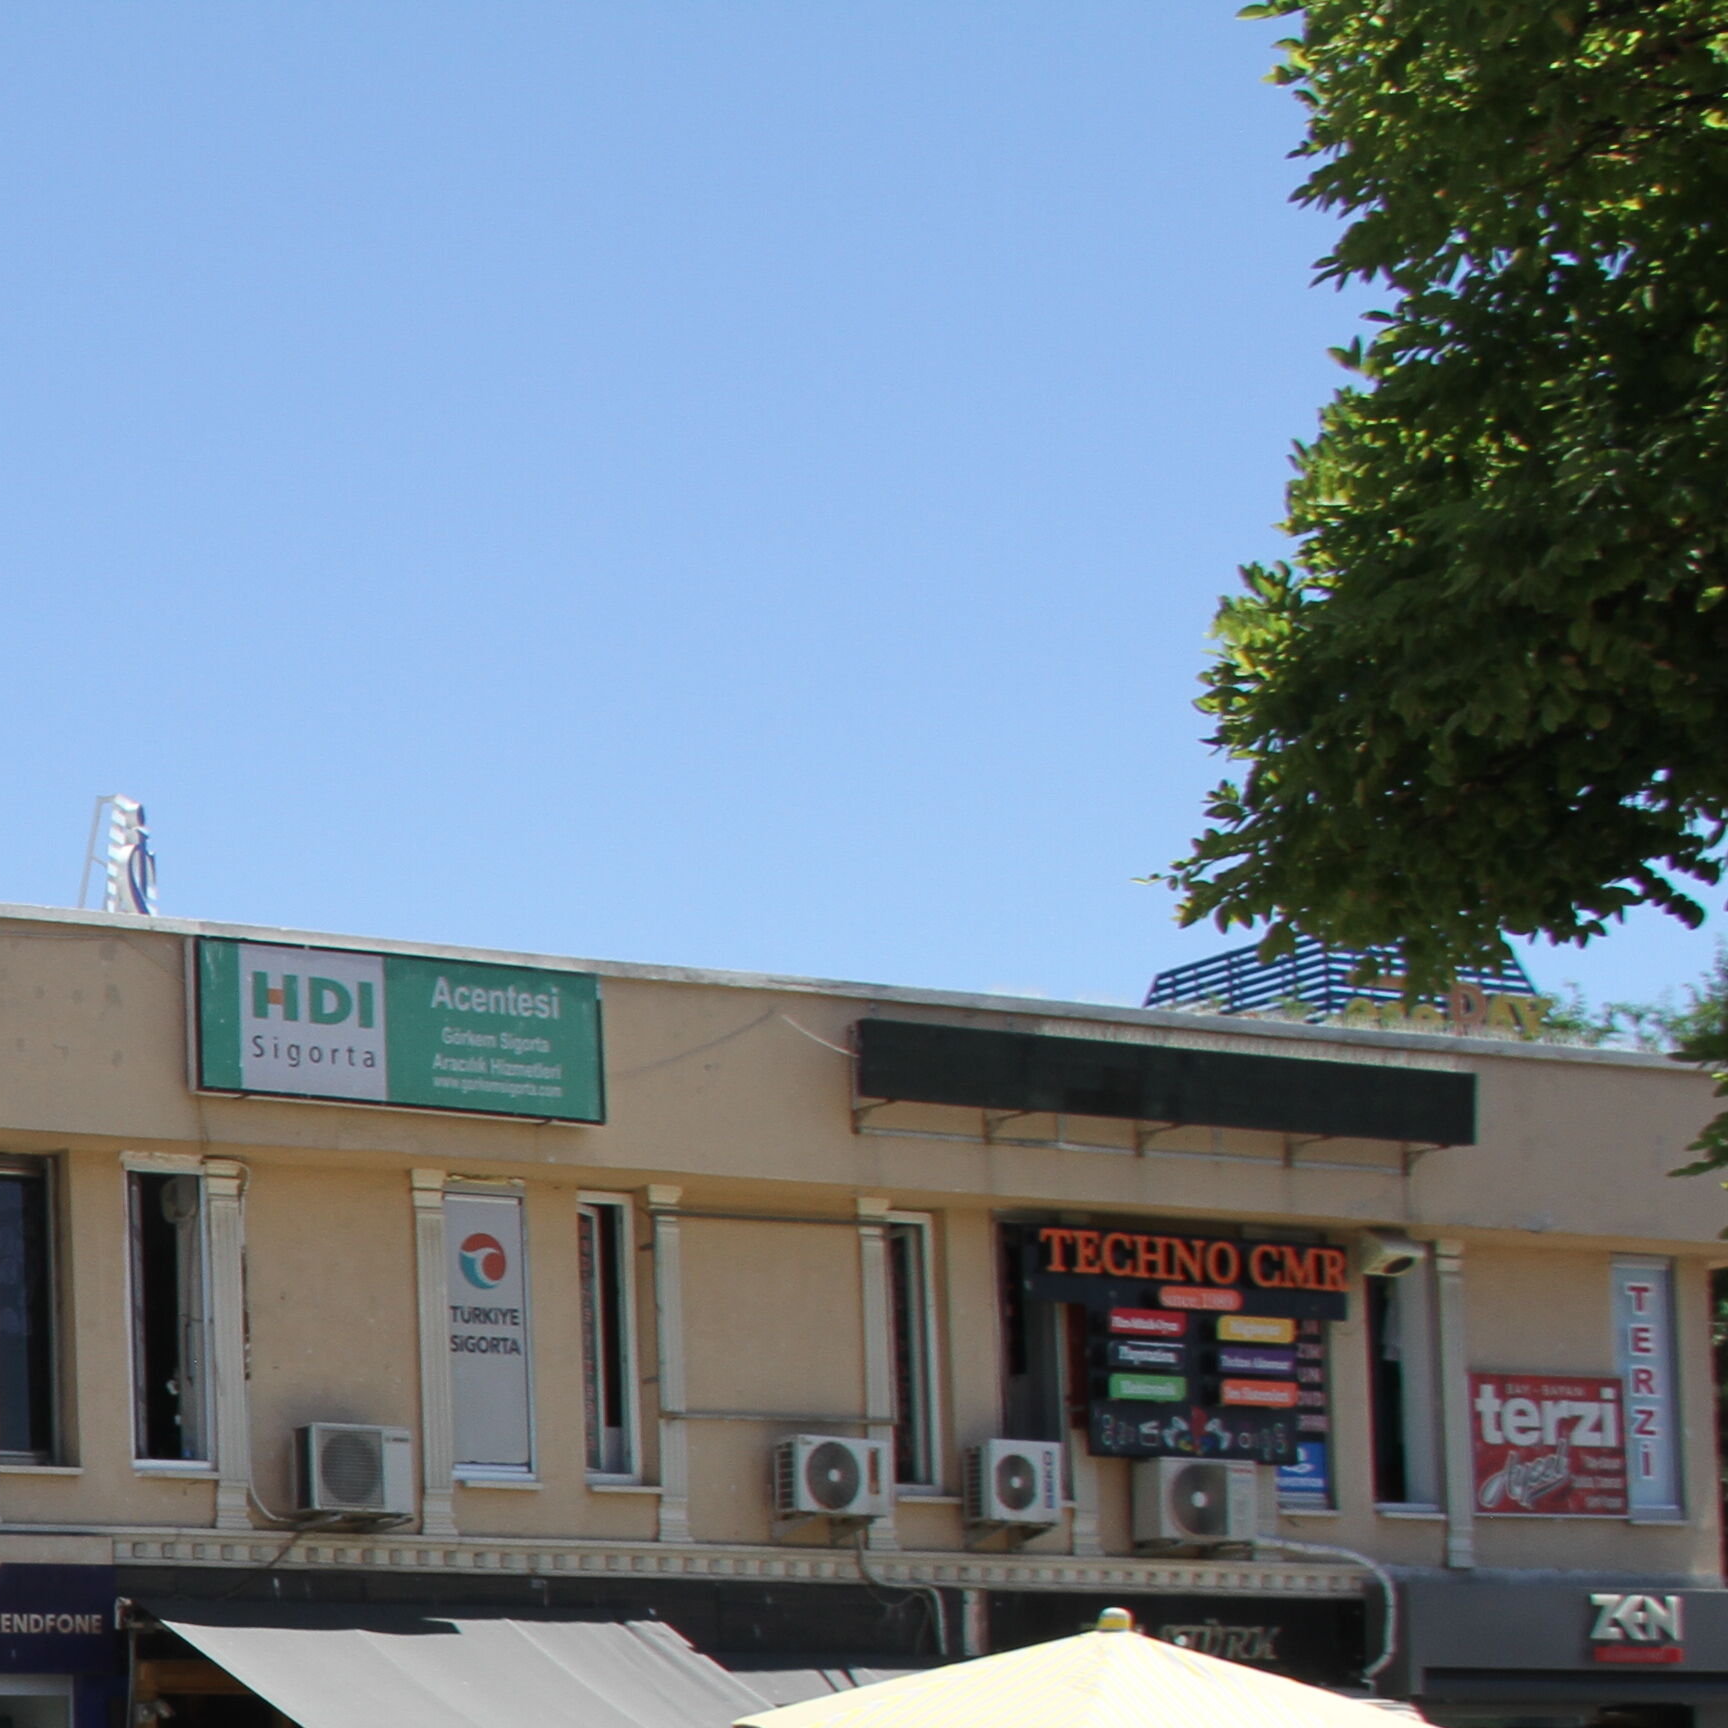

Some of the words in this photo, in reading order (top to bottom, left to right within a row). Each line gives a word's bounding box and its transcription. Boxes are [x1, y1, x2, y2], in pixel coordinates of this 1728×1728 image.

[252, 971, 374, 1029] HDI
[431, 976, 561, 1020] Acentesi
[252, 1035, 376, 1068] Sigorta
[500, 1032, 551, 1055] Sigorta
[1039, 1227, 1241, 1286] TECHNO
[1250, 1244, 1350, 1291] CMR
[1475, 1384, 1618, 1448] terzi
[1589, 1593, 1684, 1641] ZEN
